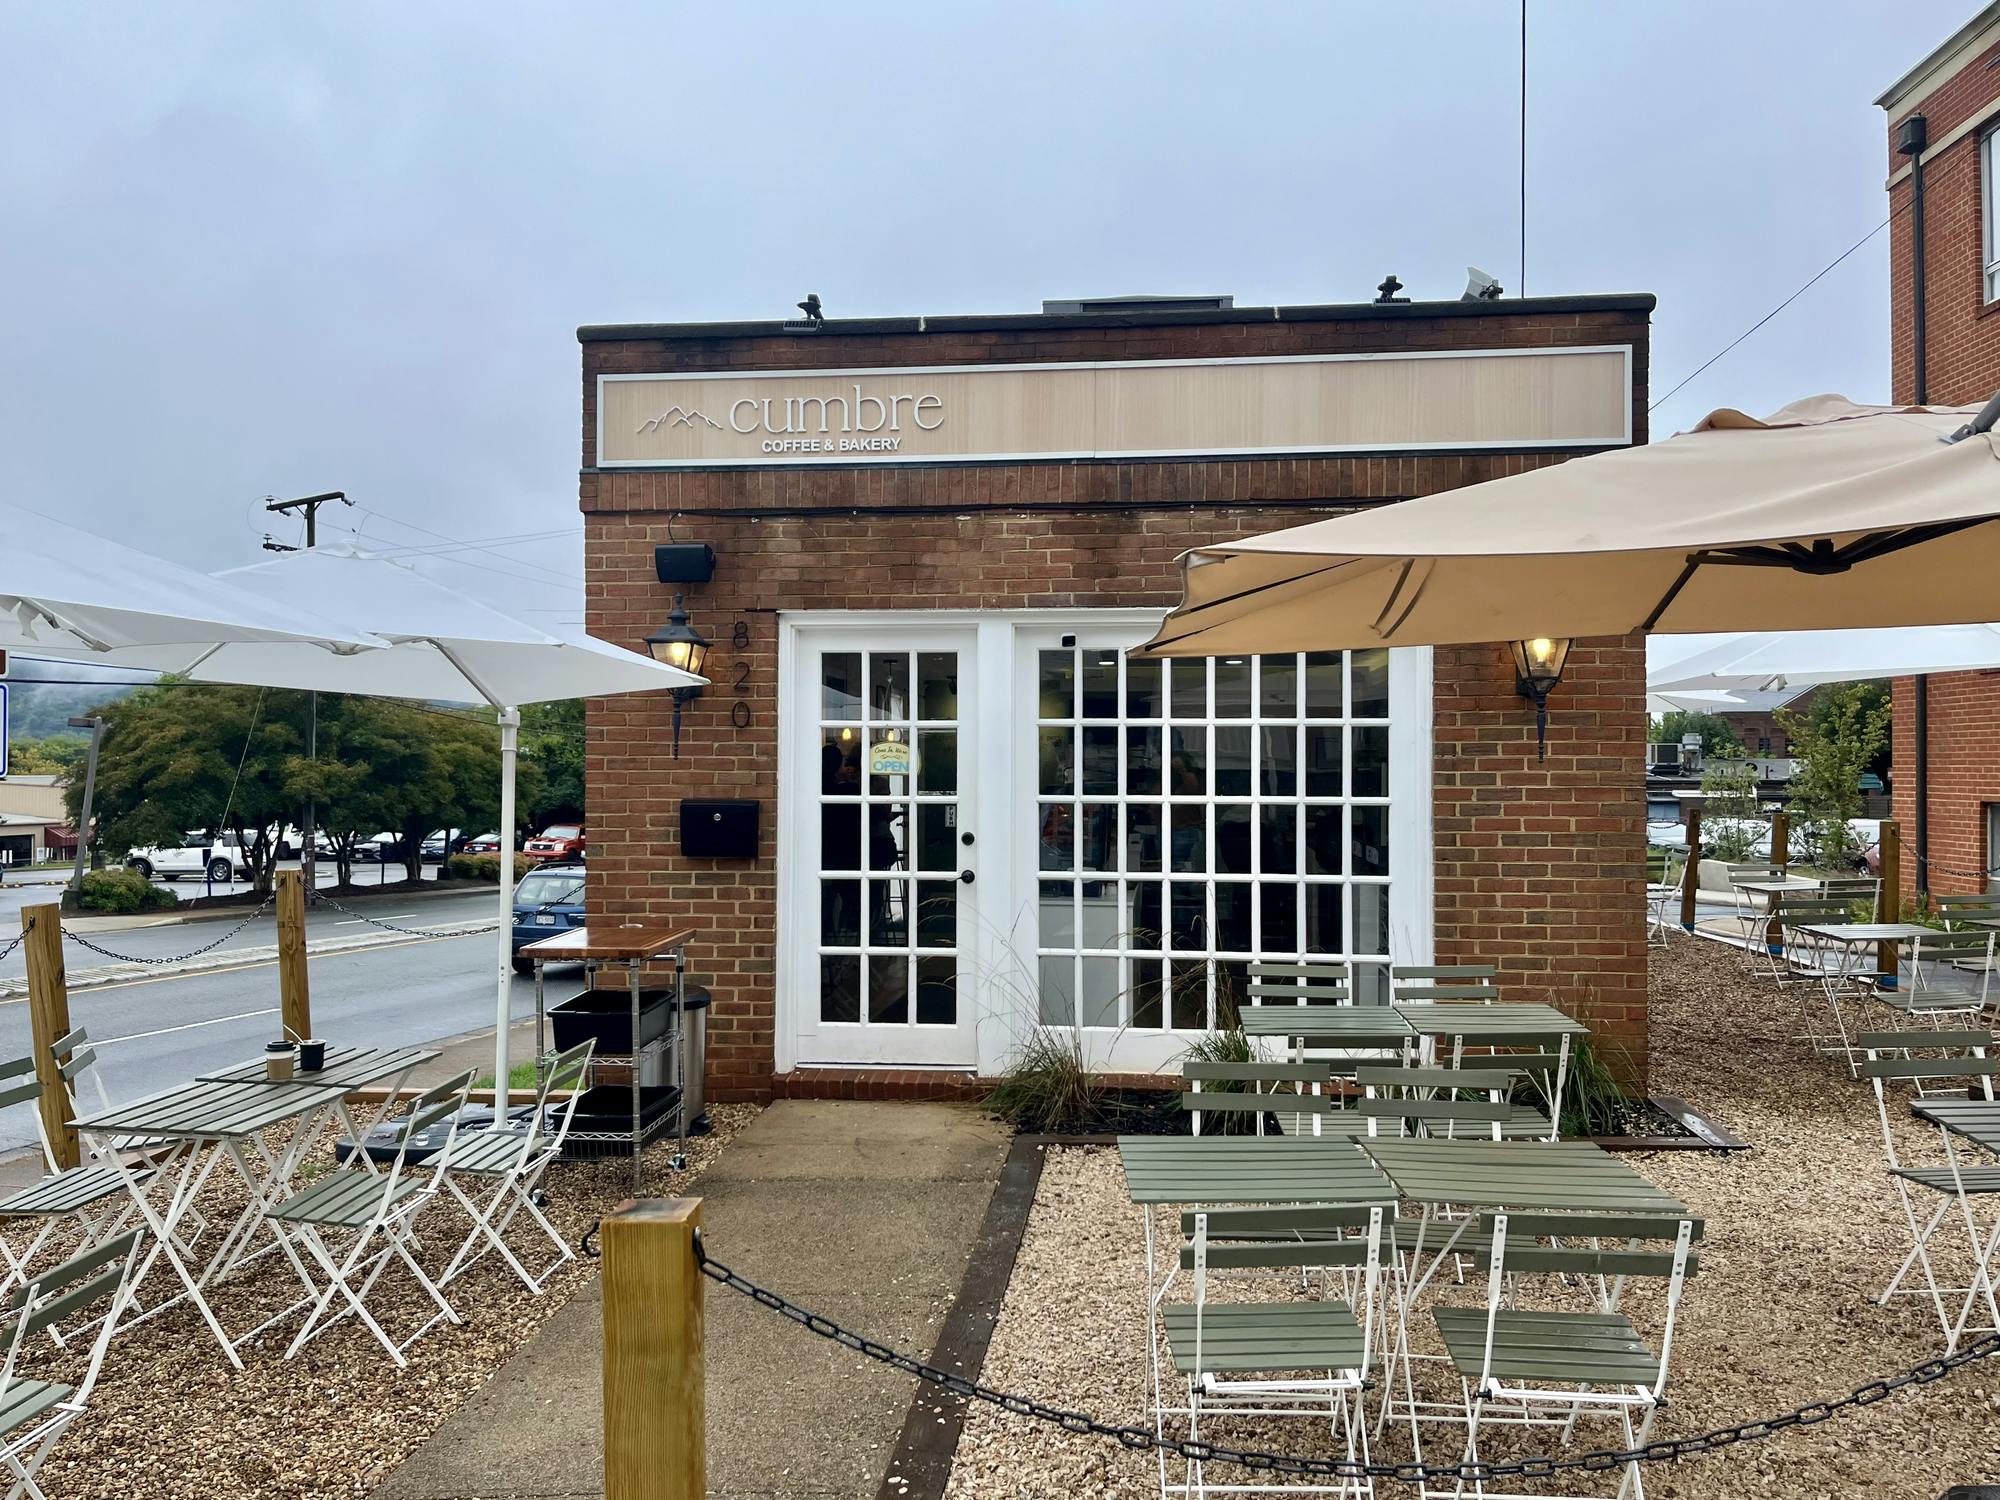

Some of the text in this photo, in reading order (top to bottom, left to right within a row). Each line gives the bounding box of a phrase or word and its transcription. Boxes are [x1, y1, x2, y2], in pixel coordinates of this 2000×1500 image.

[729, 384, 945, 433] cumbre
[761, 437, 901, 453] COFFEE & BAKERY
[732, 621, 750, 728] 820
[873, 761, 909, 771] OPEN
